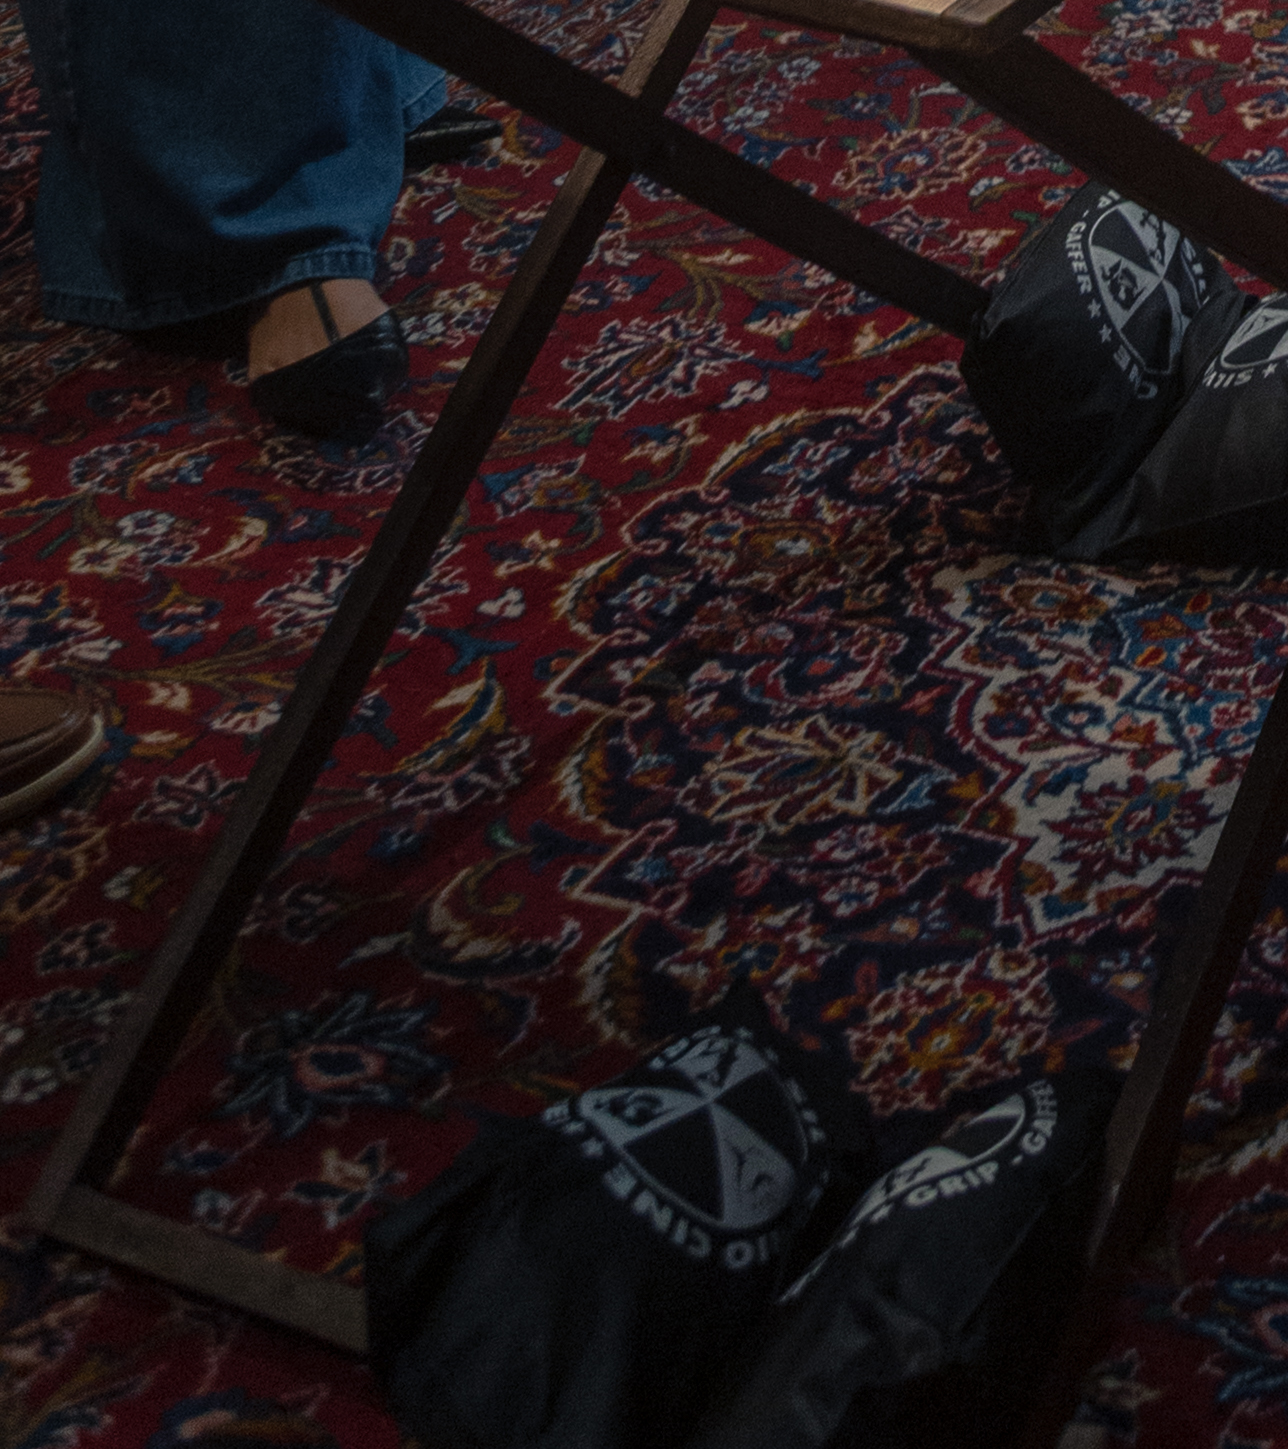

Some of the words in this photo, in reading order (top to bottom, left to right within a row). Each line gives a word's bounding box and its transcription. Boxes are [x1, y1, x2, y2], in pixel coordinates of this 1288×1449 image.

[1065, 220, 1092, 295] GAFFER
[602, 1161, 713, 1260] CINE
[904, 1160, 1001, 1208] GRIP
